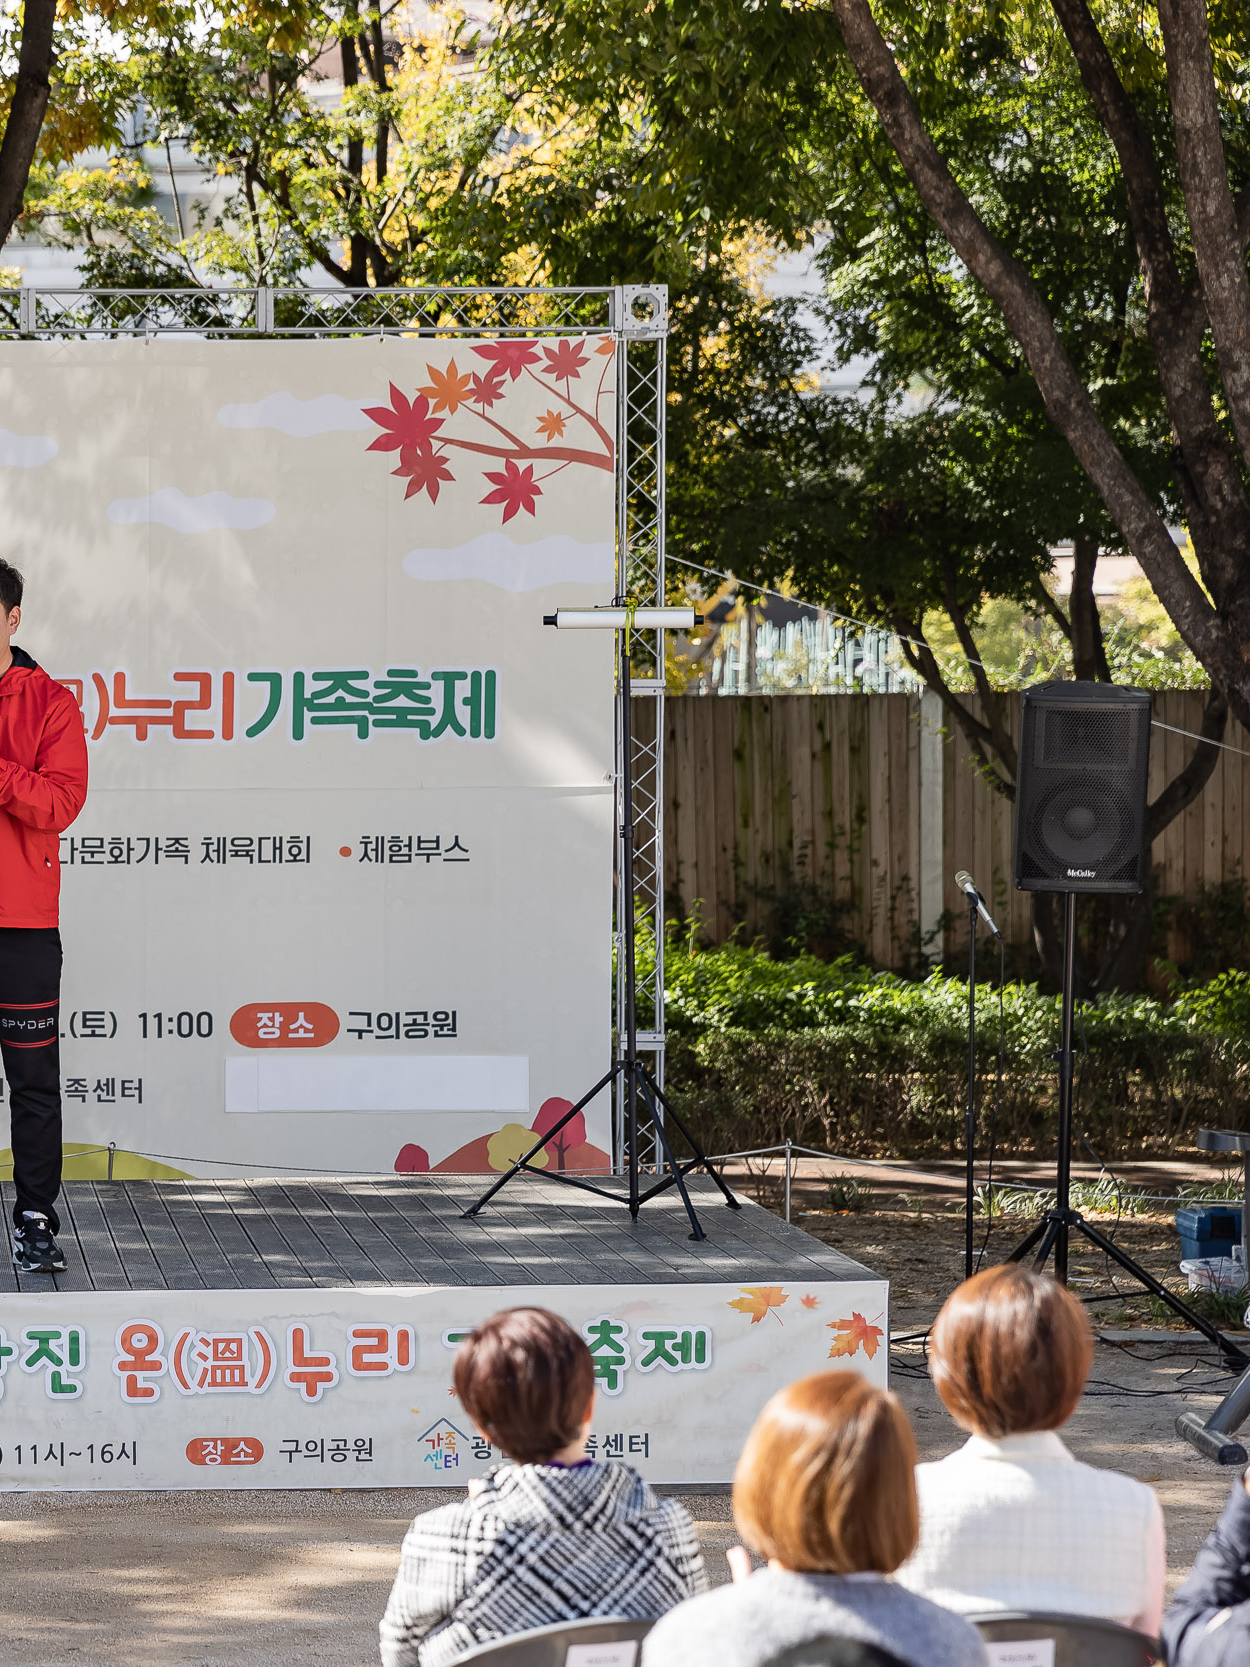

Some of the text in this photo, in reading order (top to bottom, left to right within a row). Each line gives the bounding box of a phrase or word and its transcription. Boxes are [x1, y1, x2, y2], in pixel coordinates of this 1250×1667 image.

[245, 670, 497, 741] 가족축제
[200, 836, 312, 865] 체육대회
[358, 835, 471, 865] 체험부스
[1, 1017, 55, 1030] SPYDER
[138, 1011, 213, 1039] 11:00
[256, 1012, 315, 1039] 장소
[346, 1010, 458, 1040] 구의공원
[200, 1440, 255, 1464] 장소
[279, 1437, 374, 1464] 구의공원
